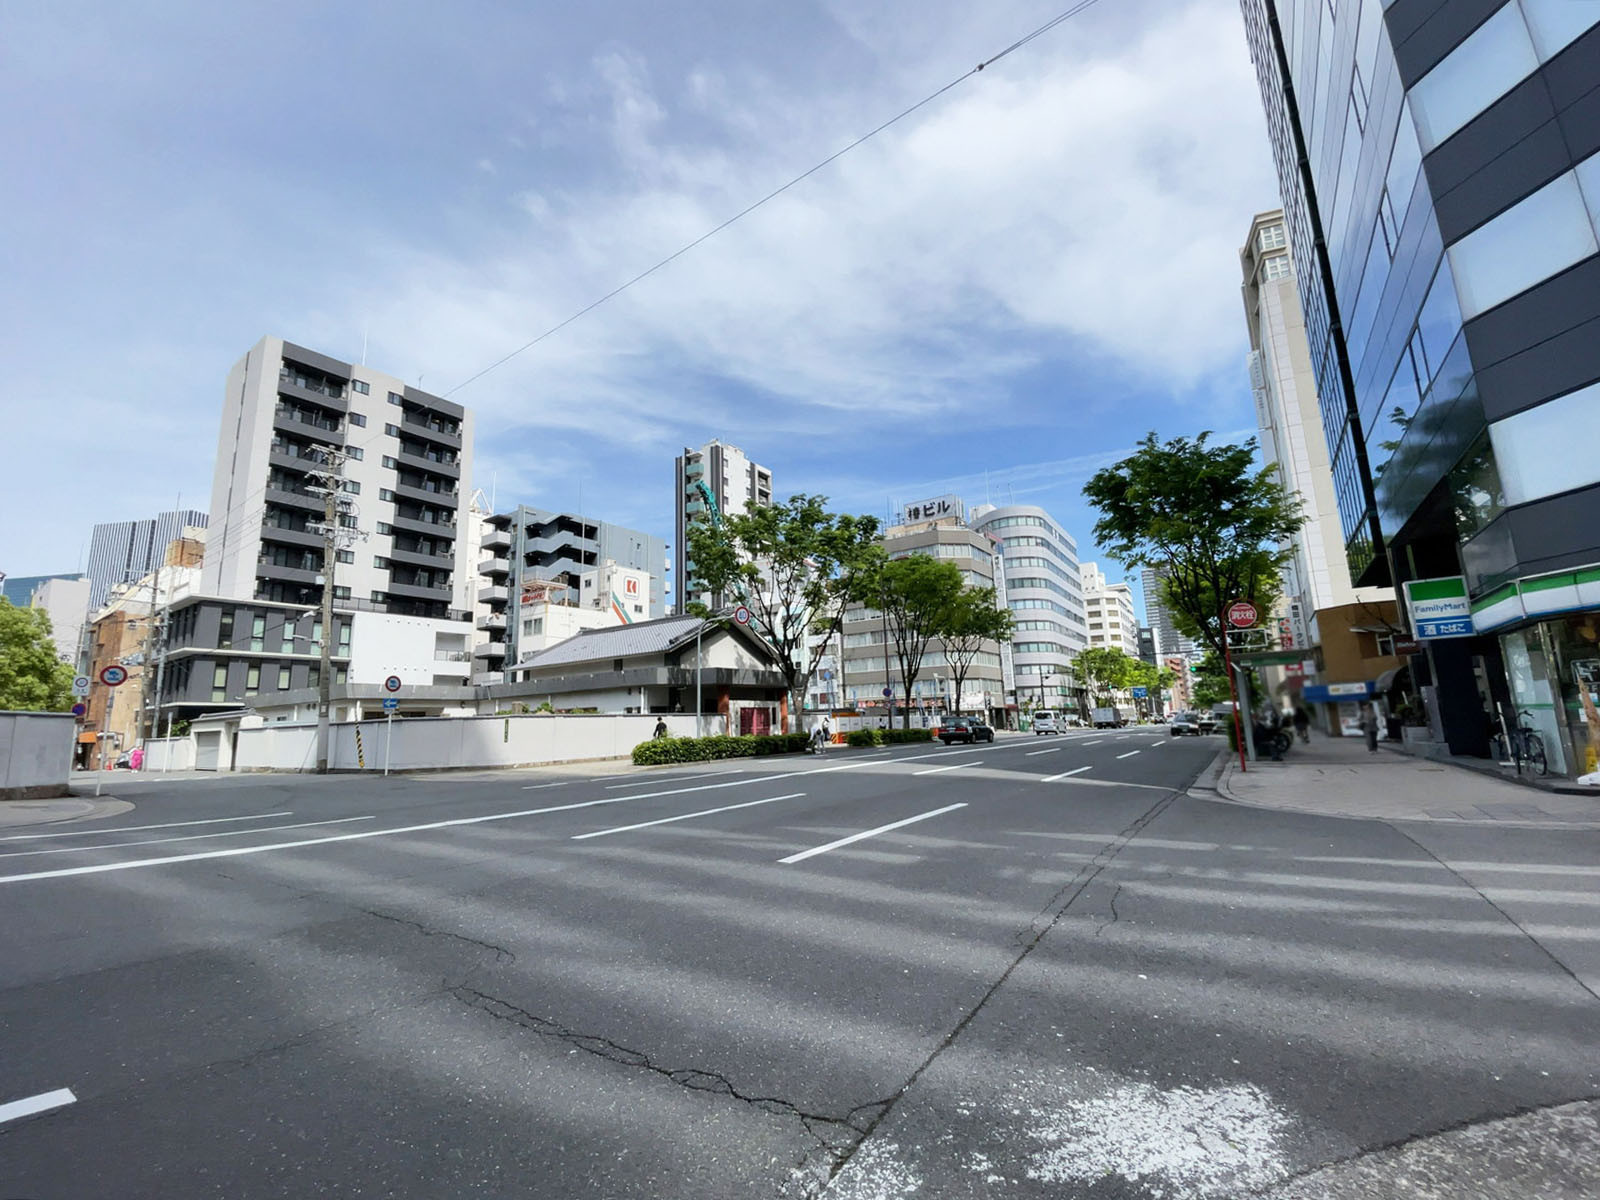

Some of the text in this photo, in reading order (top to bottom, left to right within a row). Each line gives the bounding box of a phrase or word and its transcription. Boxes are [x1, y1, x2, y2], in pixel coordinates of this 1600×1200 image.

[1414, 602, 1466, 613] FamilyMart
[1231, 610, 1255, 620] 消火栓
[1440, 623, 1466, 634] たばこ
